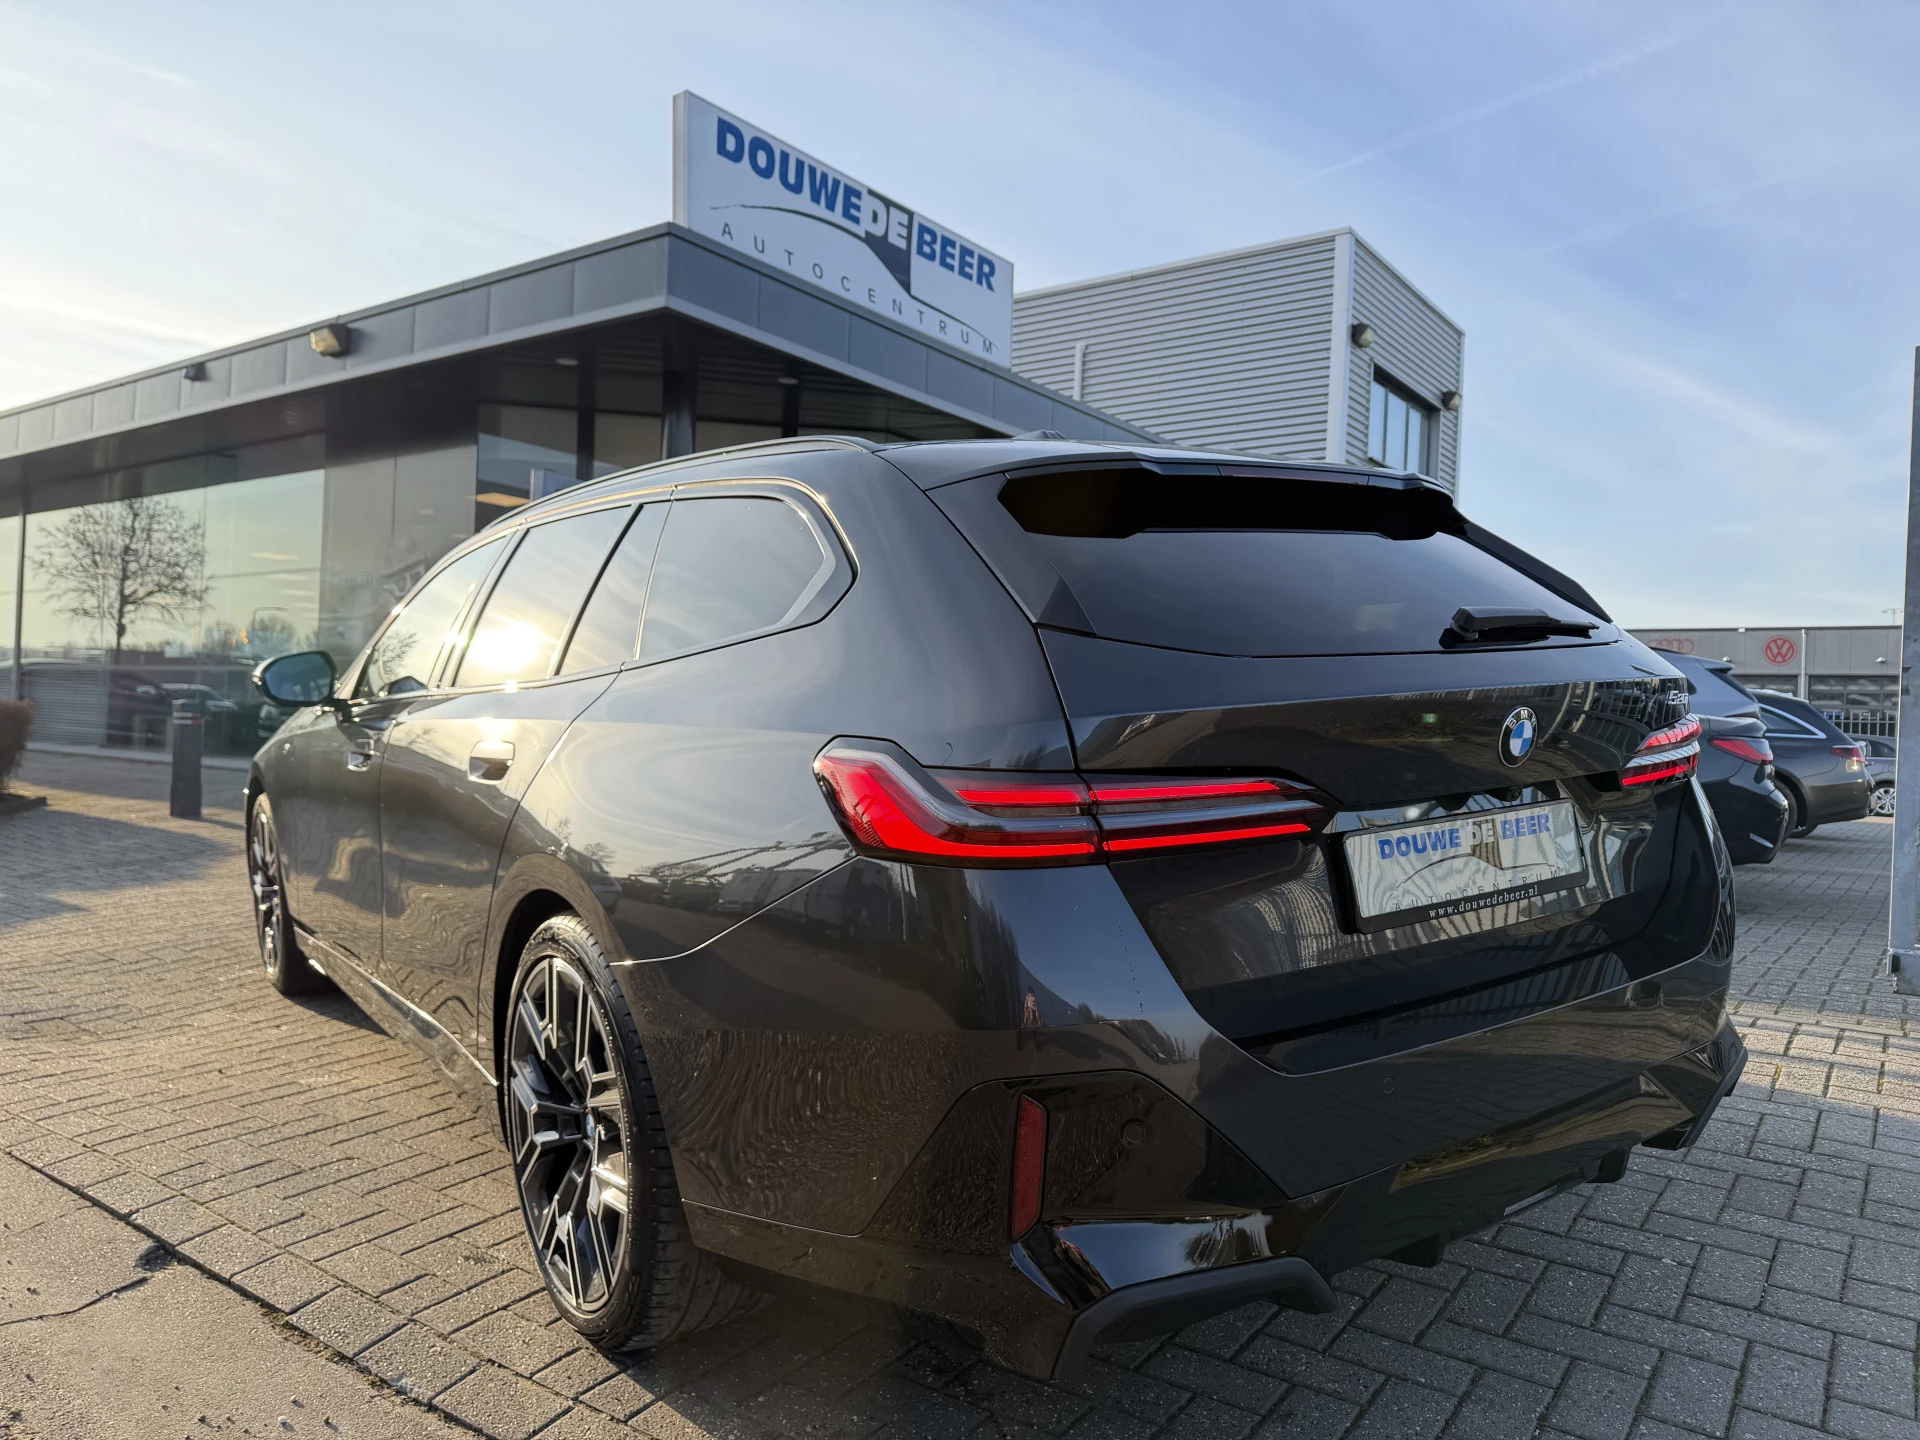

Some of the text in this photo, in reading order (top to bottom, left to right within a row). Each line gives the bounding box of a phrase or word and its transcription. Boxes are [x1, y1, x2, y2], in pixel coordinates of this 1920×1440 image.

[716, 116, 996, 293] DOUWE DE BEER
[721, 222, 993, 354] AUTOCENTRUM
[1378, 813, 1551, 859] DOUWE DE BEER
[1429, 885, 1538, 918] www.douwedebeer.nl
